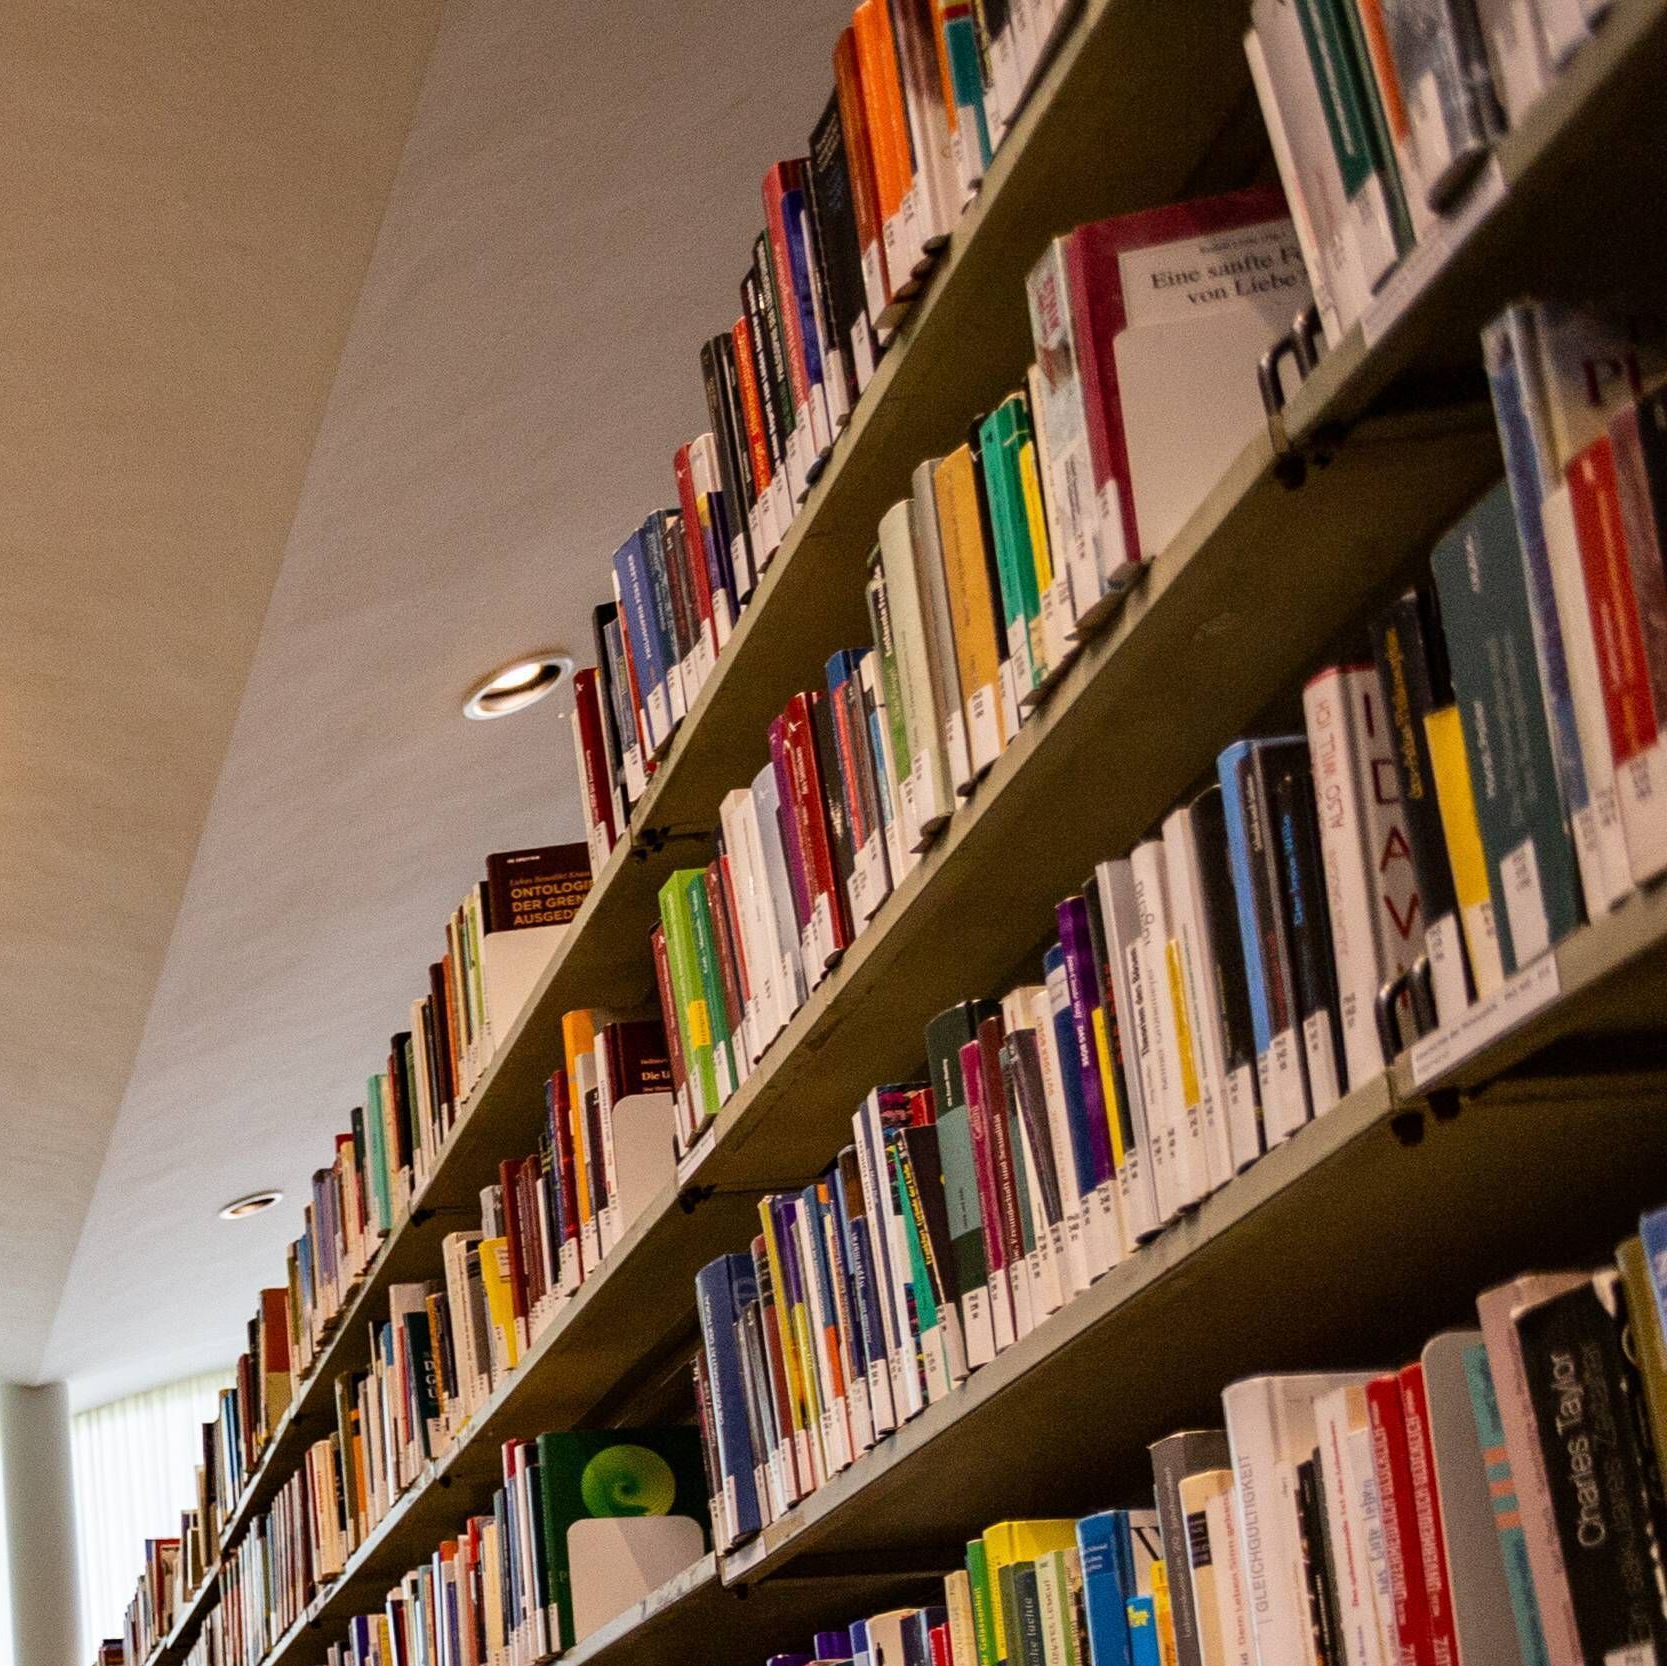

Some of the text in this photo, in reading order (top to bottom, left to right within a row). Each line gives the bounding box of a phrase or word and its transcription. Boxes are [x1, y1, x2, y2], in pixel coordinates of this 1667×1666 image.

[1150, 247, 1273, 291] Eine sanfte
[1187, 265, 1298, 306] von Liebe
[510, 877, 594, 900] ONTOLOGIE
[992, 1113, 1006, 1158] Sexualität
[1001, 1180, 1017, 1243] Freundschaft
[1546, 1351, 1606, 1547] Charles Taylor
[972, 1587, 988, 1649] Gelassenheit
[1022, 1597, 1037, 1636] lachte
